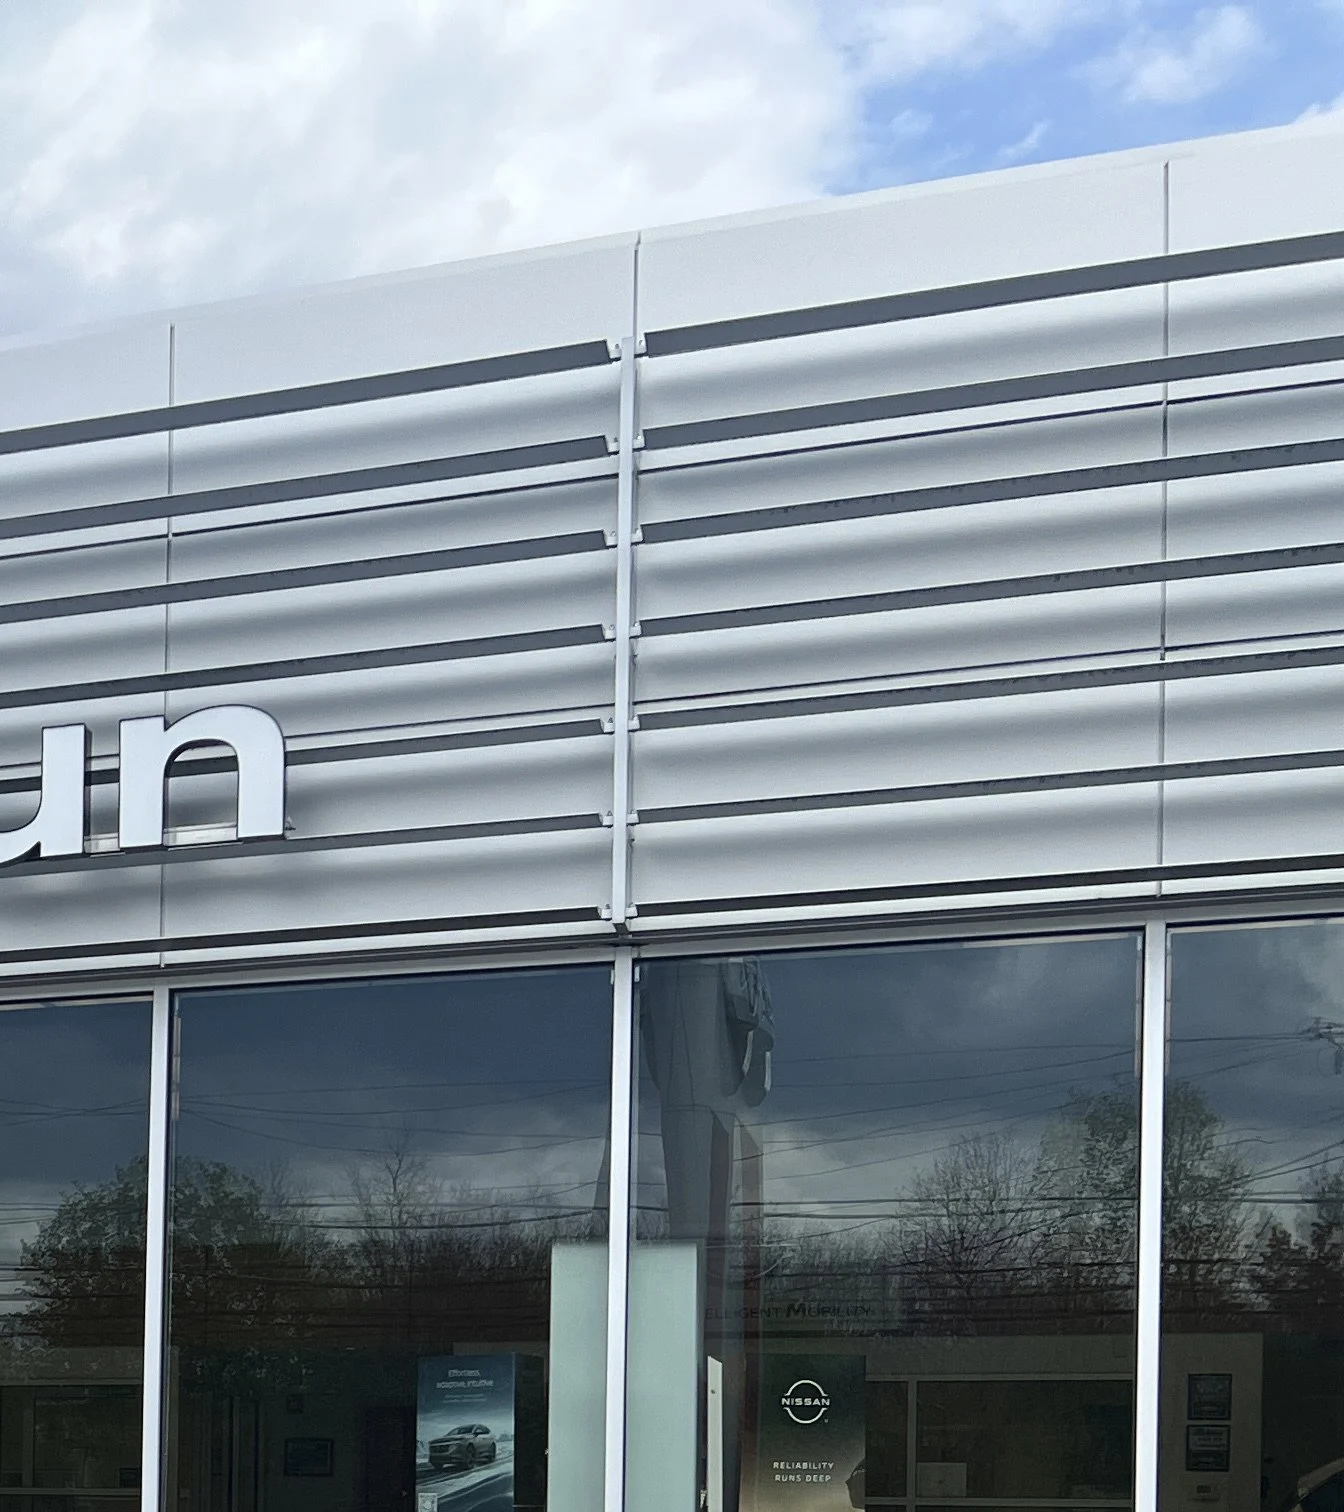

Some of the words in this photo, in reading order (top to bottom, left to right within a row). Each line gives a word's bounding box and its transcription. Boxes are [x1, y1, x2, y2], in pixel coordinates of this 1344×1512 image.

[781, 1397, 831, 1406] NISSAN
[773, 1461, 835, 1470] RELIABILITY
[774, 1474, 802, 1482] RUNS
[805, 1474, 832, 1482] DEEP
